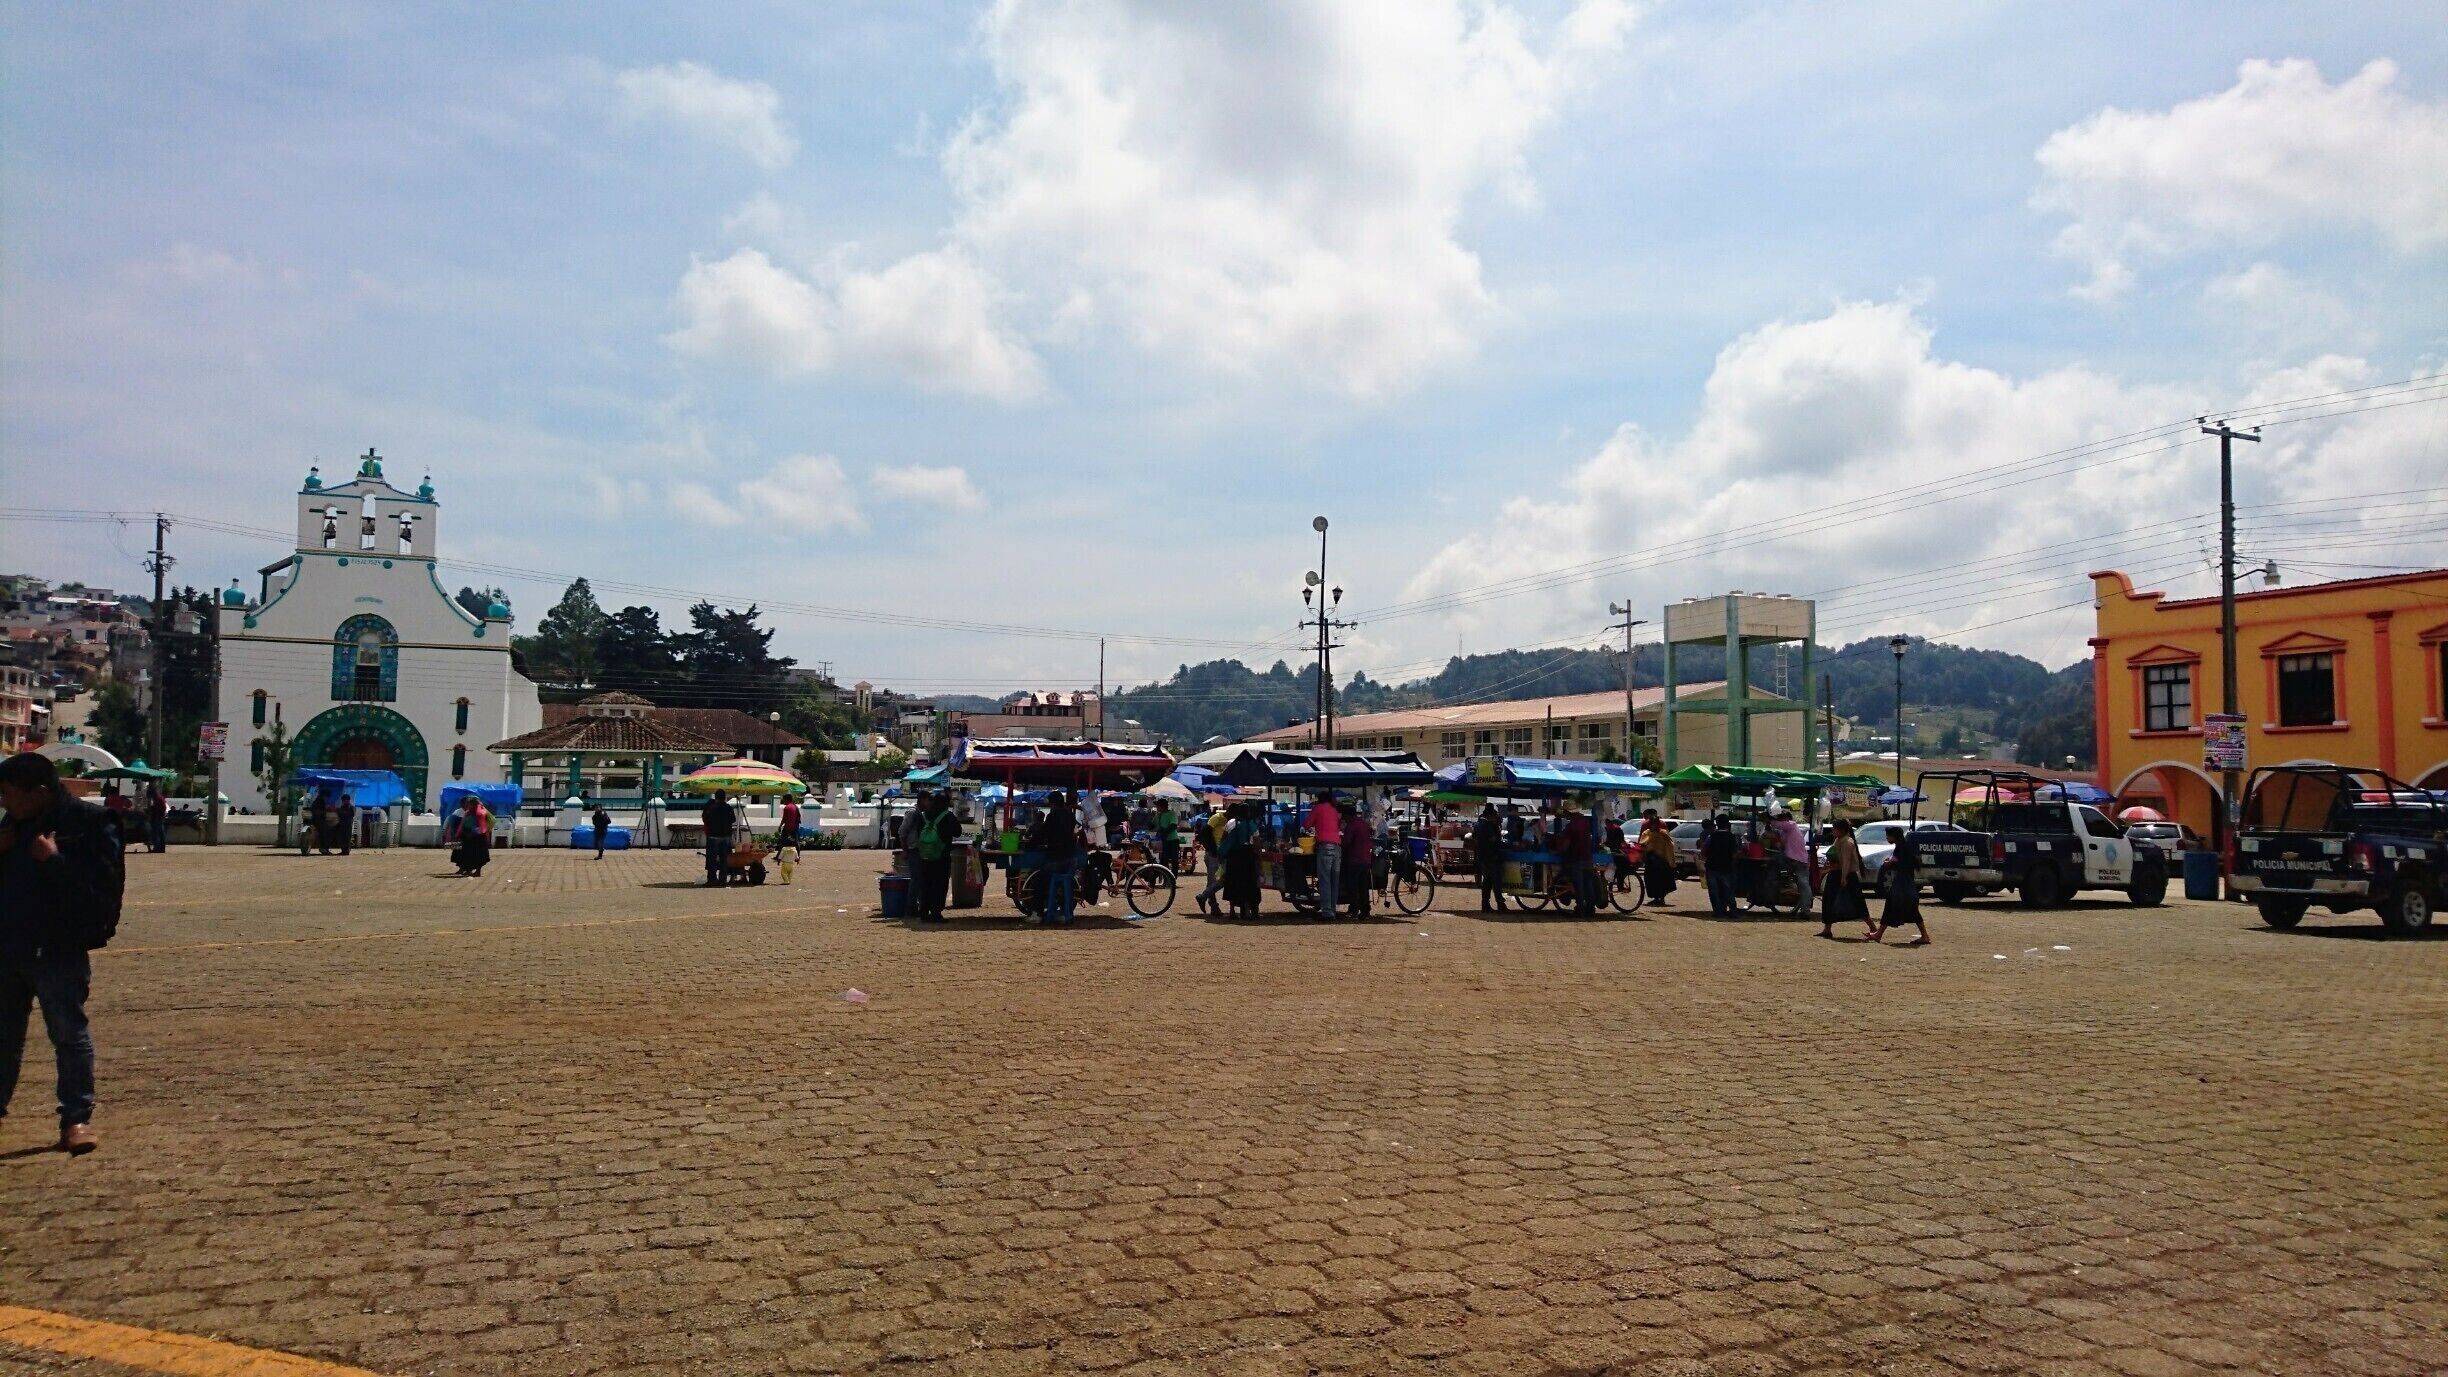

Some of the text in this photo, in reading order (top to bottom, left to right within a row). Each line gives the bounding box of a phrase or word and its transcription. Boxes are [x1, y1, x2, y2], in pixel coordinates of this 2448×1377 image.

[1919, 843, 1977, 853] POLICIA MUNICIPAL
[2253, 859, 2333, 872] POLICIA MUNICIPAL
